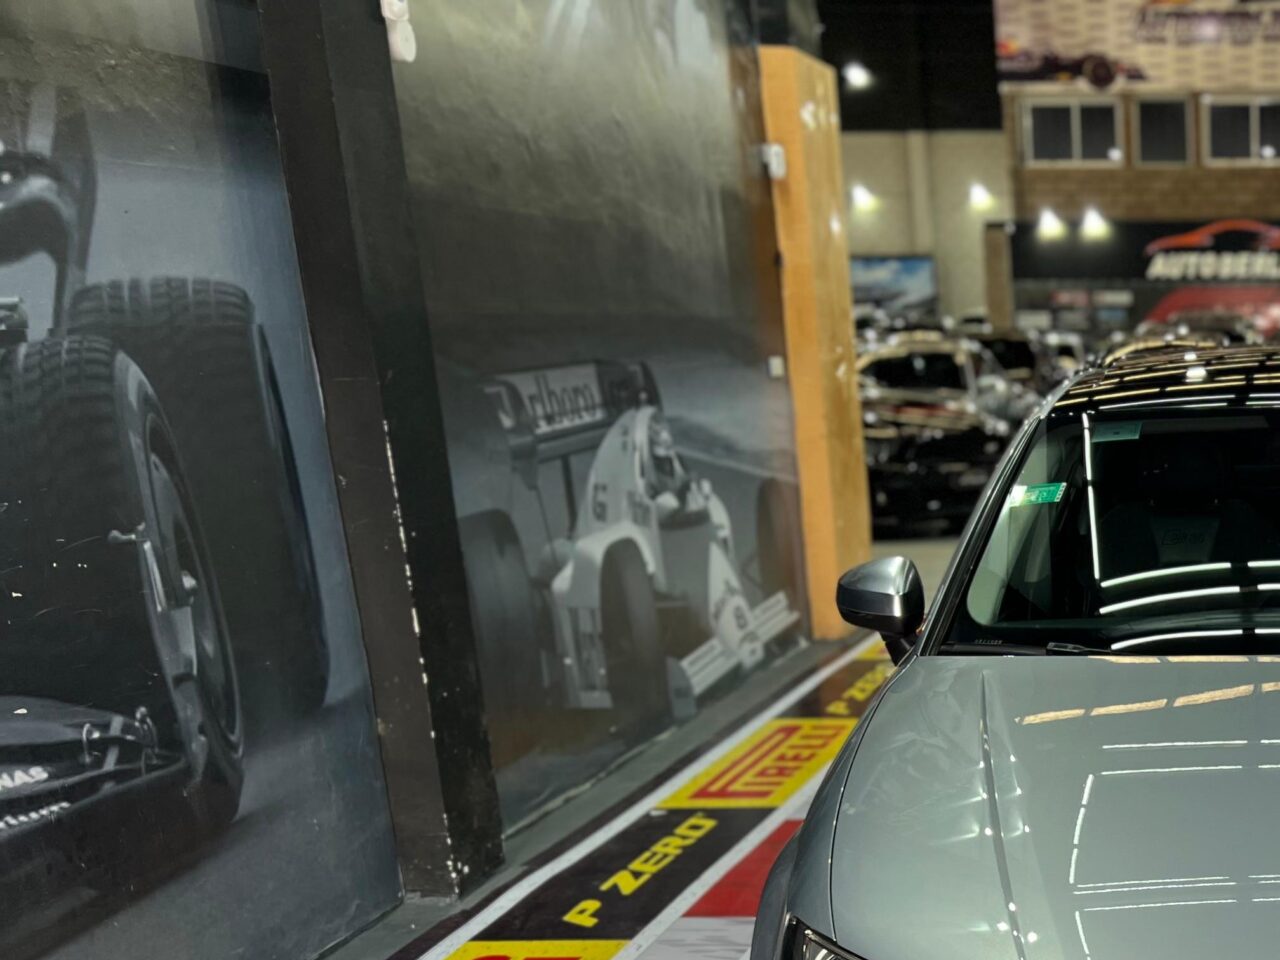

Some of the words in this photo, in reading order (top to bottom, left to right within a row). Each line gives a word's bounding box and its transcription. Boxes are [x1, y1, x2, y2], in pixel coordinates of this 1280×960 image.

[525, 371, 606, 425] rlboro
[689, 725, 848, 800] PIRELLI
[562, 899, 602, 928] P
[599, 817, 718, 895] ZERO
